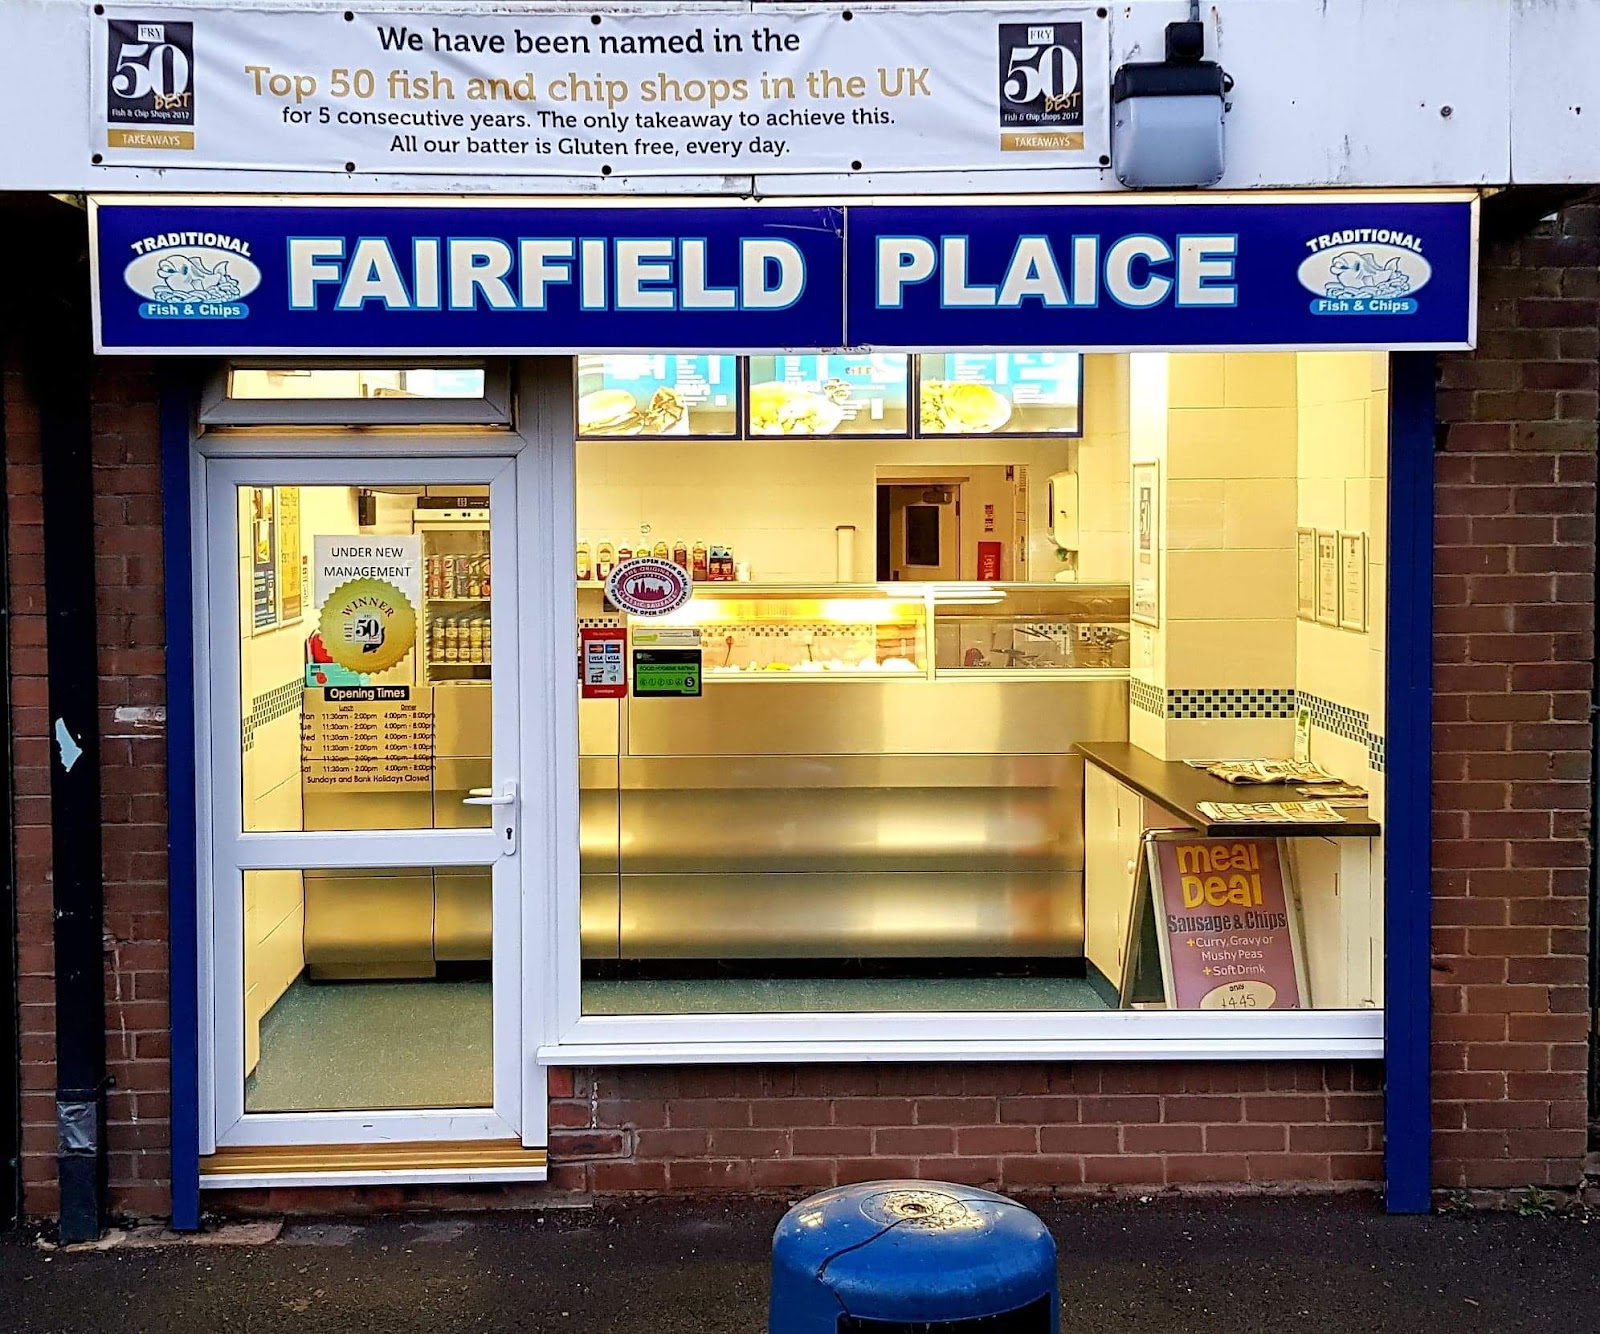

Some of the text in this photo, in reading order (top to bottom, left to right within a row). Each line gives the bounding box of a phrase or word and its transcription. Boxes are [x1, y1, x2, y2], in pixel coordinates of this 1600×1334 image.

[140, 28, 162, 38] FRY
[1030, 30, 1052, 40] FRY
[377, 27, 800, 54] We have been named in the
[112, 43, 189, 99] 50
[1004, 45, 1078, 103] 50
[245, 66, 931, 109] Top 50 fish and chip shops in the UK
[1044, 92, 1081, 112] BEST
[134, 108, 150, 118] Chip
[151, 110, 171, 120] Shops
[172, 111, 190, 120] 2017
[282, 107, 896, 132] for 5 consecutive years. The only takeaway to achieve this.
[1026, 113, 1040, 122] Chip
[1041, 112, 1060, 122] Shops
[122, 134, 180, 146] TAKEAWAYS
[390, 135, 790, 158] All our batter is Gluten free, every day.
[1015, 136, 1070, 147] TAKEAWAYS
[131, 232, 252, 257] TRADITIONAL
[1306, 228, 1424, 252] TRADITIONAL
[287, 233, 1239, 311] FAIRFIELD PLAICE
[148, 304, 241, 318] Fish & Chips
[1318, 300, 1410, 312] Fish & Chips
[331, 547, 404, 558] UNDER NEW
[324, 566, 412, 577] MANAGEMENT
[611, 568, 622, 584] OPEN
[624, 560, 640, 570] OPEN
[660, 561, 677, 571] OPEN
[676, 570, 688, 586] OPEN
[624, 568, 638, 578] THE
[640, 566, 673, 578] ORIGINAL
[618, 590, 645, 608] CLASSIC
[342, 596, 394, 618] WINNER
[622, 604, 638, 614] OPEN
[658, 606, 674, 614] OPEN
[356, 620, 379, 637] 50
[330, 688, 406, 700] Opening Times
[308, 776, 336, 784] Sundays
[374, 774, 403, 784] Holidays
[1181, 874, 1262, 908] Deal
[1168, 911, 1286, 933] Sausage & Chips
[1230, 936, 1260, 947] Gravy
[1202, 950, 1263, 961] Mushy Peas
[1213, 965, 1236, 976] Soft
[1238, 964, 1266, 974] Drink
